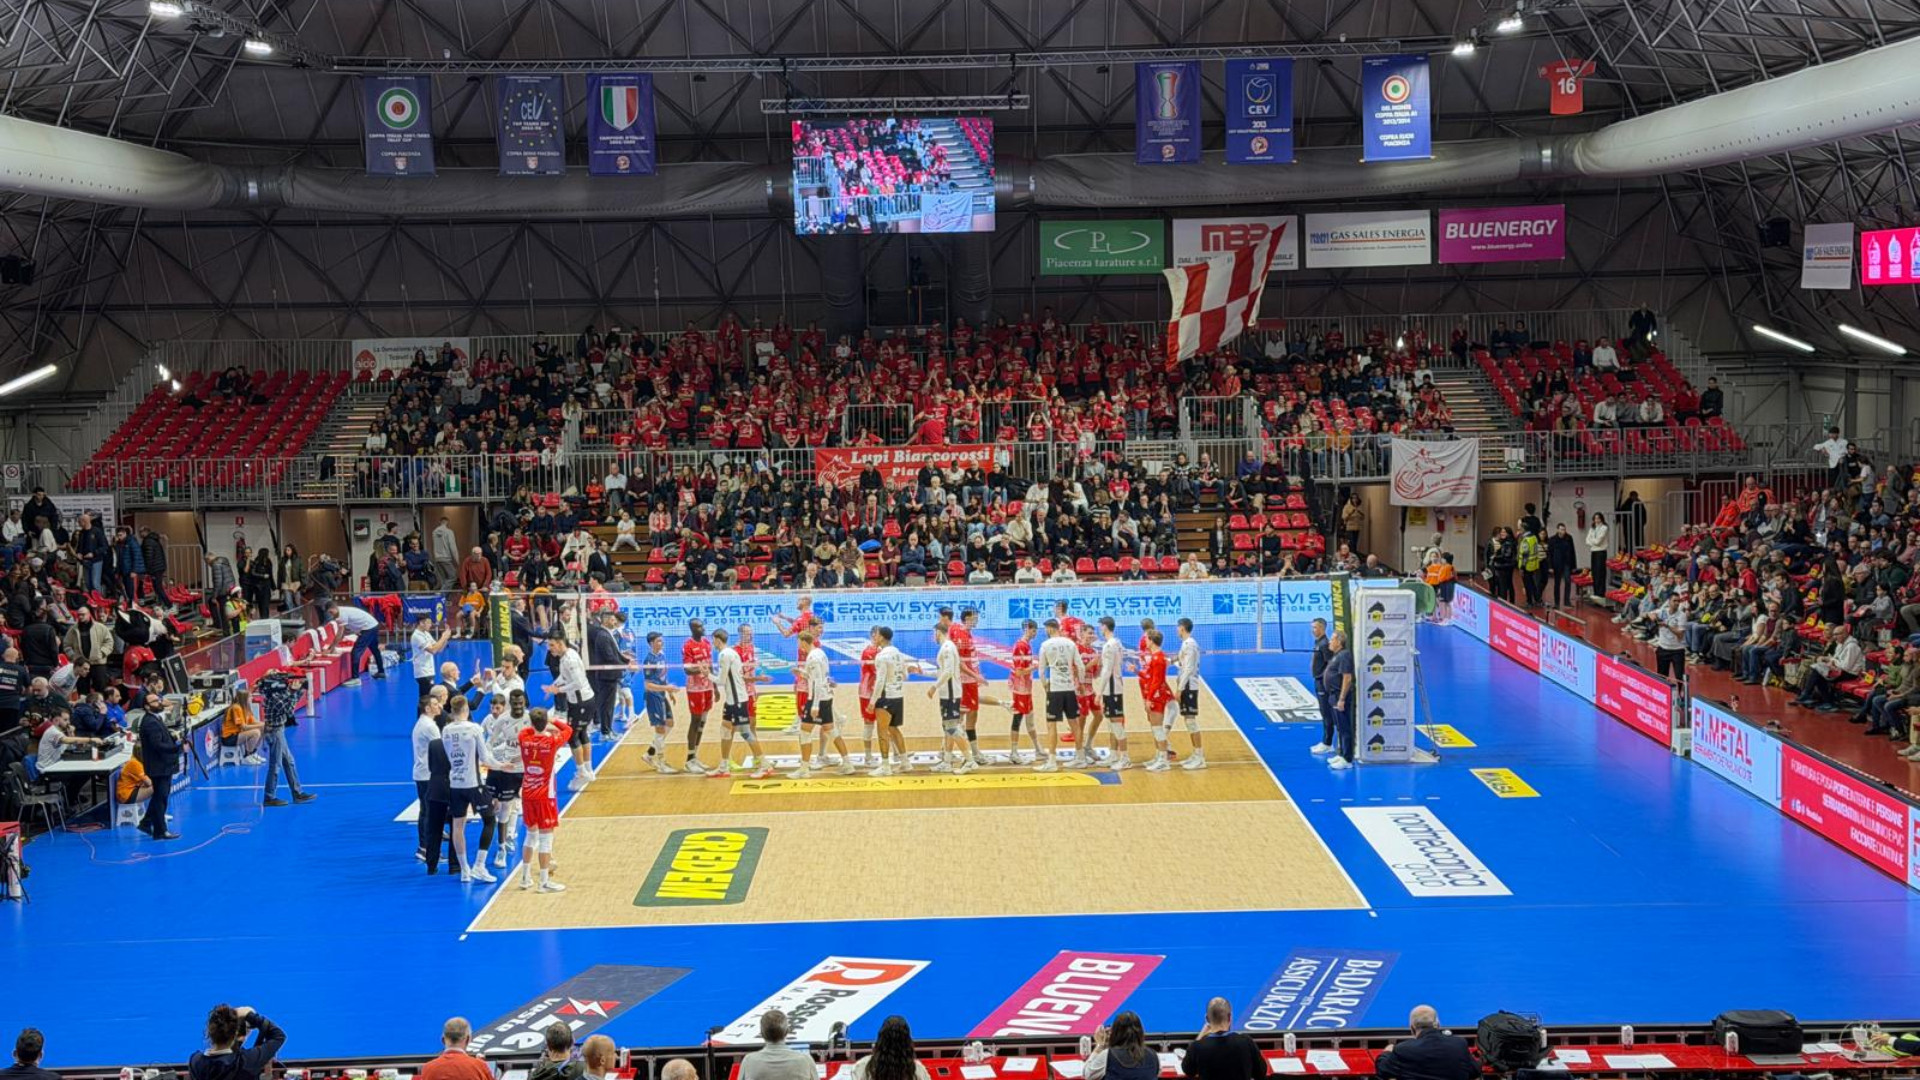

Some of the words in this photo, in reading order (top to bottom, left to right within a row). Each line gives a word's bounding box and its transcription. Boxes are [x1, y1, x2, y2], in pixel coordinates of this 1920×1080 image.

[1558, 78, 1576, 94] 16
[521, 92, 547, 120] CEV
[1248, 106, 1270, 114] CEV
[1331, 231, 1350, 240] GAS
[1353, 230, 1381, 239] SALES
[1383, 229, 1425, 238] ENERGIA
[1446, 219, 1557, 239] BLUENERGY
[1047, 257, 1092, 268] Piacenza
[1095, 258, 1135, 267] tarature
[851, 449, 889, 465] Lupi
[893, 447, 990, 463] Biancorossi
[837, 601, 905, 614] ERREVI
[909, 599, 985, 613] SYSTEM
[1032, 597, 1100, 610] EREVI
[1105, 595, 1181, 608] SYSTEM
[1250, 604, 1311, 613] SLUIONS
[499, 600, 511, 637] BANCA
[632, 606, 700, 619] ERREVI
[704, 604, 781, 618] SYSTEM
[1049, 609, 1105, 618] SUTIONS
[1114, 607, 1181, 616] CONSULTING
[648, 618, 706, 626] SOLUTIS
[714, 616, 777, 625] CONSULTI
[1694, 707, 1752, 766] FI.METAL
[1386, 812, 1487, 887] nordmeccanica
[654, 831, 750, 900] CREDEM
[1392, 863, 1447, 888] group
[1306, 959, 1383, 1030] BADARAC
